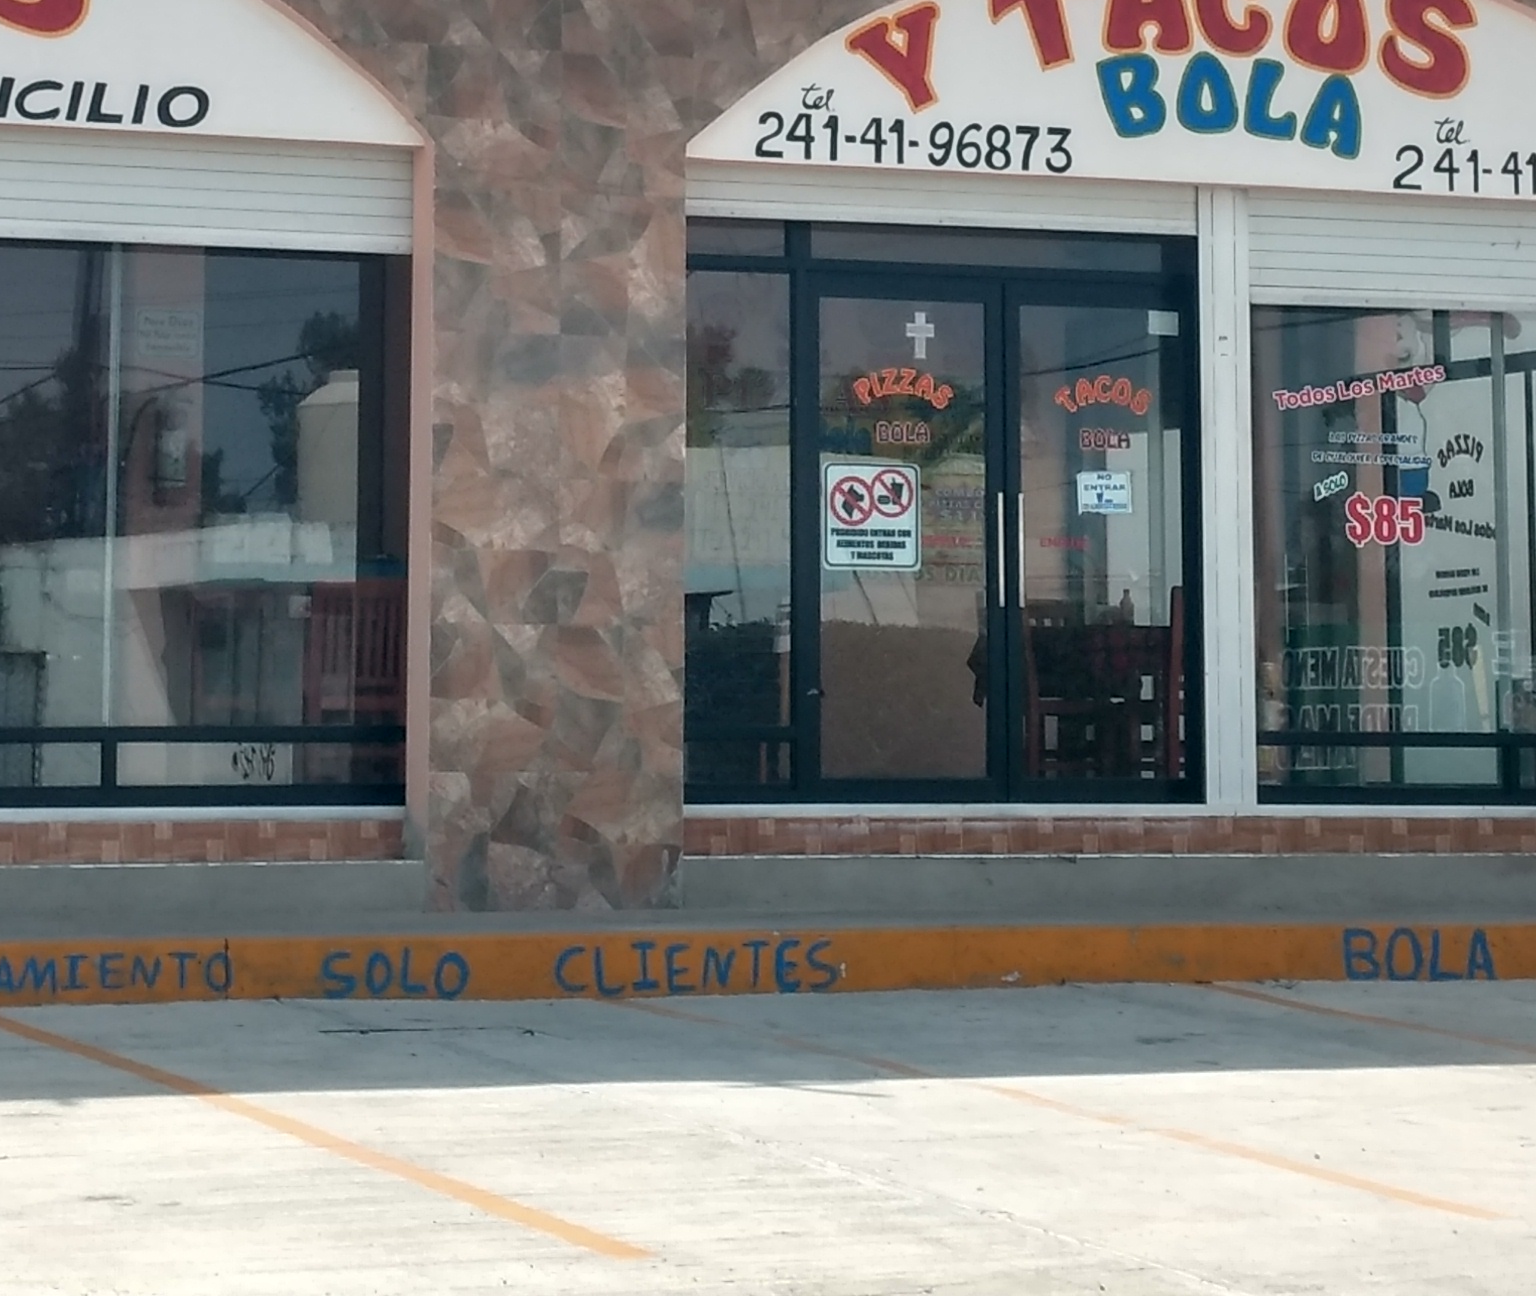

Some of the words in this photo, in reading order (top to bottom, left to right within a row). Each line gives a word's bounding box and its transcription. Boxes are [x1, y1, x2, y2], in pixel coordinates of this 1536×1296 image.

[846, 1, 939, 110] Y
[1096, 51, 1362, 160] BOLA
[755, 111, 1073, 174] 241-41-96873
[853, 368, 954, 409] PIZZAS
[1054, 375, 1152, 416] TACOS
[1273, 383, 1336, 410] Todos
[1337, 377, 1374, 400] Los
[1377, 364, 1446, 392] Martes
[875, 421, 931, 443] BOLA
[1079, 428, 1131, 450] BOLA
[1321, 470, 1349, 496] SOLO
[1345, 492, 1425, 547] $85
[322, 948, 470, 1000] SOLO
[555, 940, 839, 997] CLIENTES
[1342, 926, 1498, 980] BOLA
